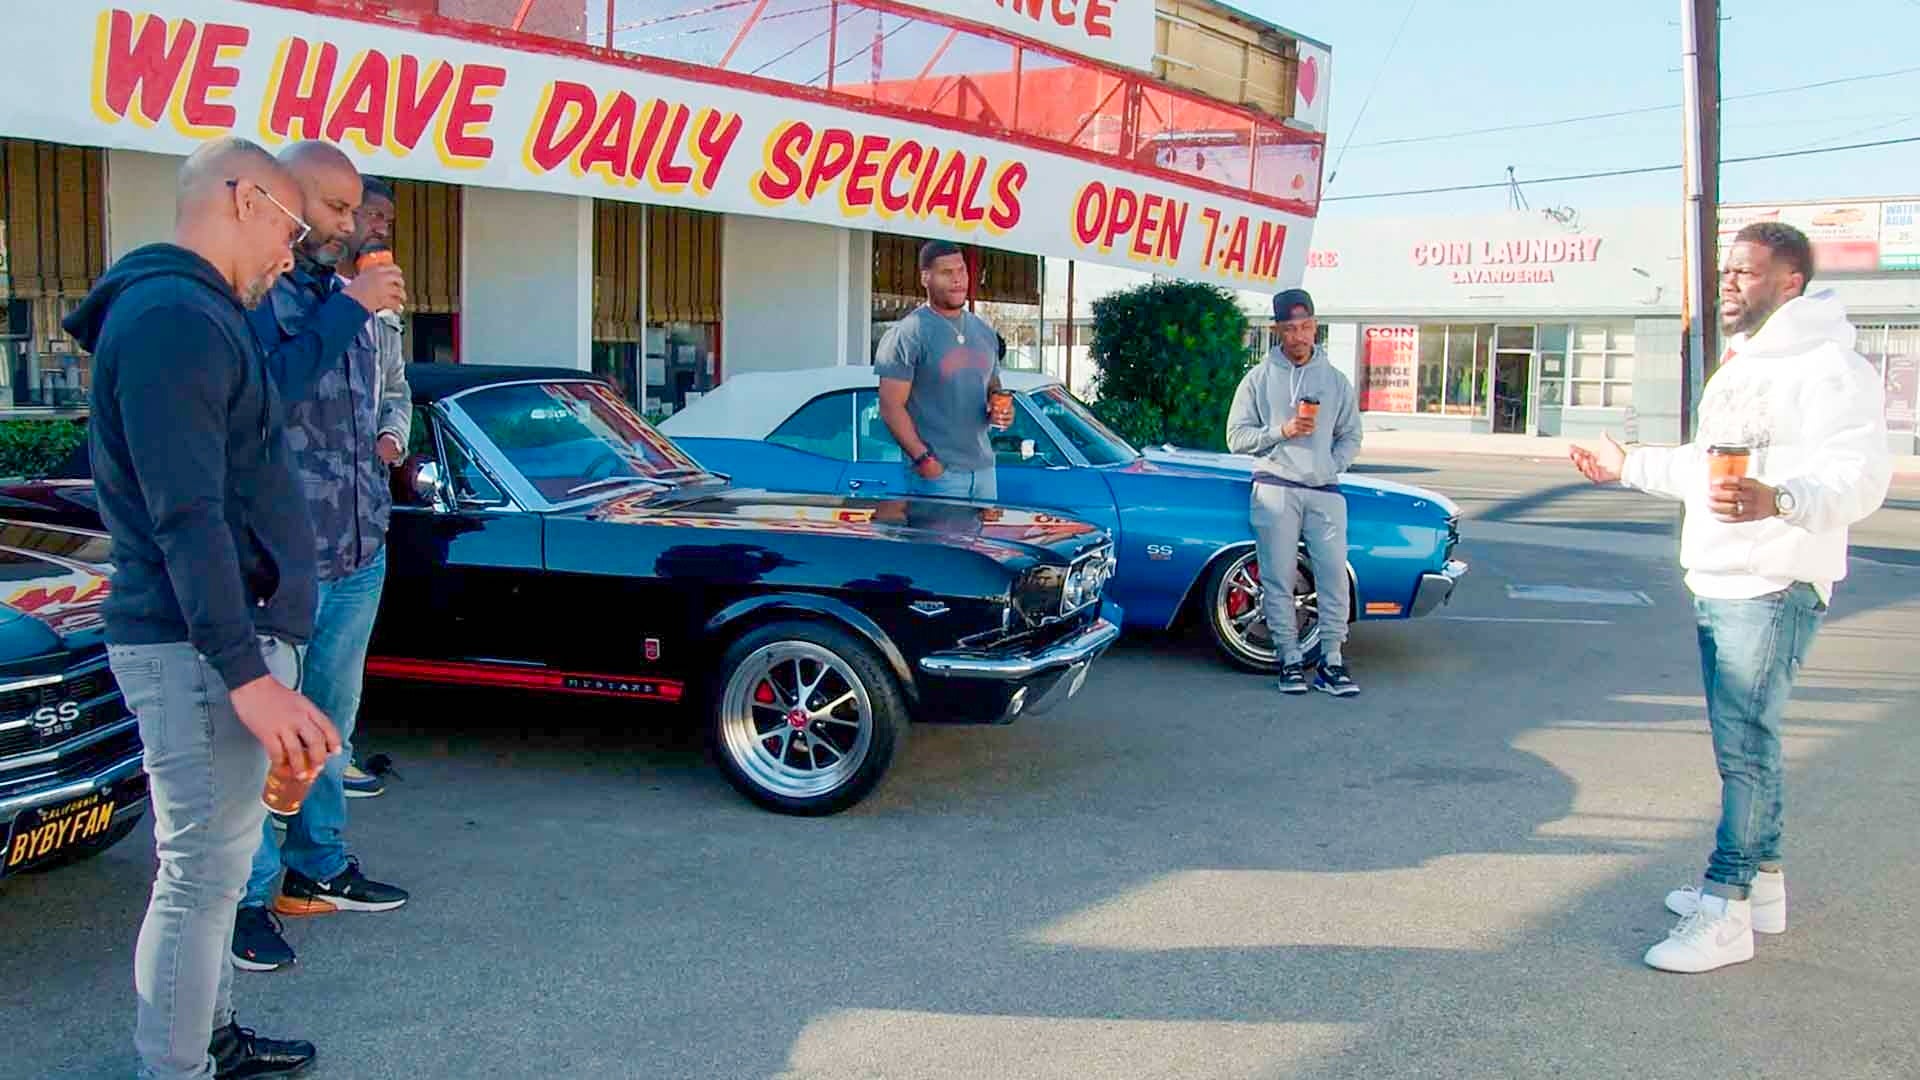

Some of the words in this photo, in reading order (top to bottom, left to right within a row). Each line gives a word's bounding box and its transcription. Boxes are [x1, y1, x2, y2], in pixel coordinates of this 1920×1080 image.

[93, 10, 249, 137] WE
[259, 36, 506, 168] HAVE
[523, 80, 742, 196] DAILY
[751, 119, 1027, 235] SPECIALS
[1073, 181, 1189, 264] OPEN
[1410, 239, 1472, 266] COIN
[1482, 236, 1603, 265] LAUNDRY
[1449, 269, 1555, 285] LAVANDERIA
[1366, 327, 1414, 338] COIN
[1146, 544, 1173, 555] SS
[34, 701, 80, 729] SS
[41, 794, 99, 822] CALIFORNIA
